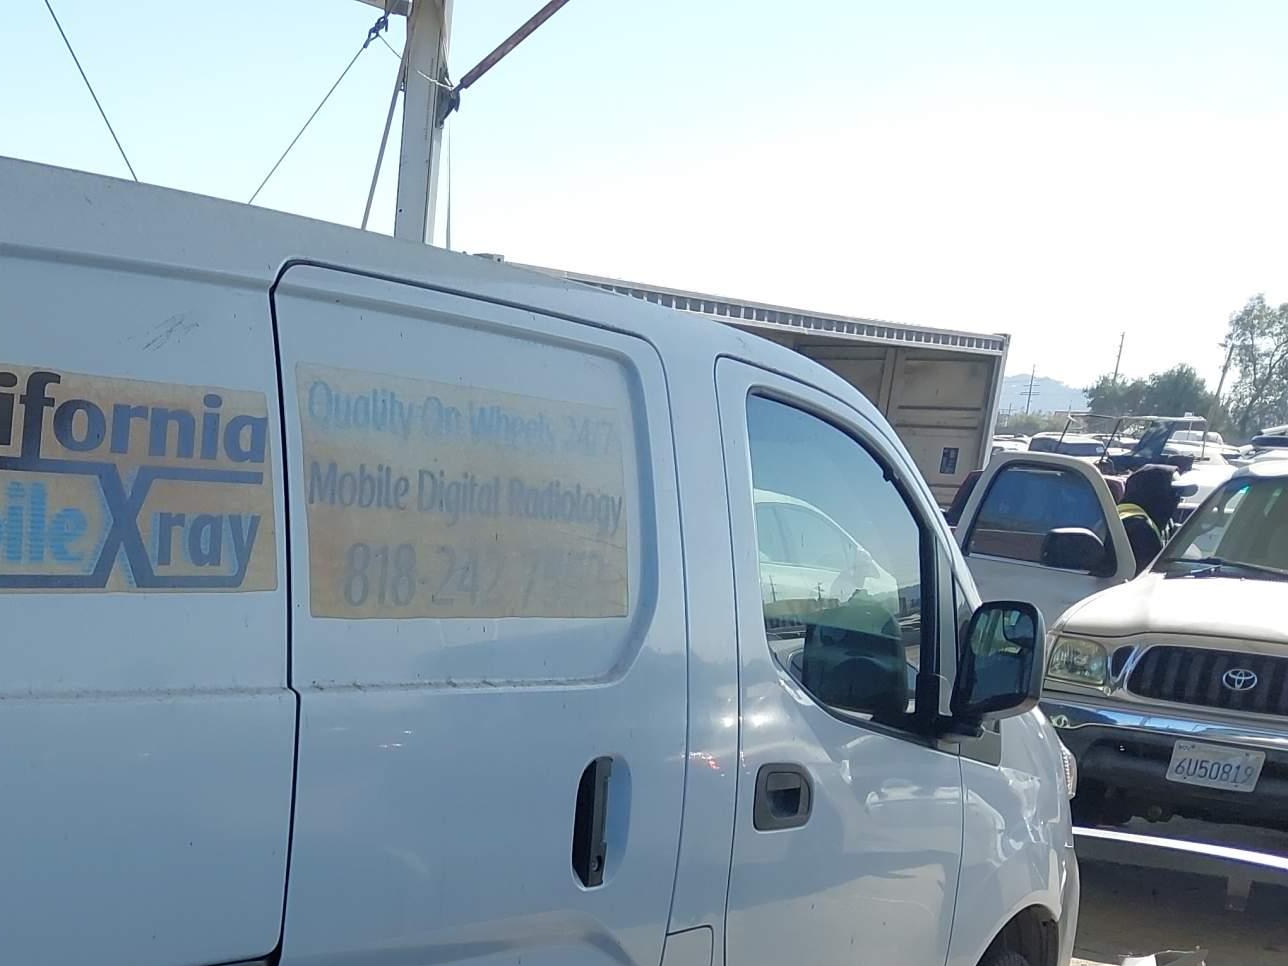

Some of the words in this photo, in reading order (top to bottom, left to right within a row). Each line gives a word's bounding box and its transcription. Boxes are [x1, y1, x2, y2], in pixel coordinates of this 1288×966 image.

[308, 380, 411, 438] Quality
[309, 461, 410, 511] Mobile
[418, 469, 500, 528] Digital
[511, 476, 623, 538] Radiology
